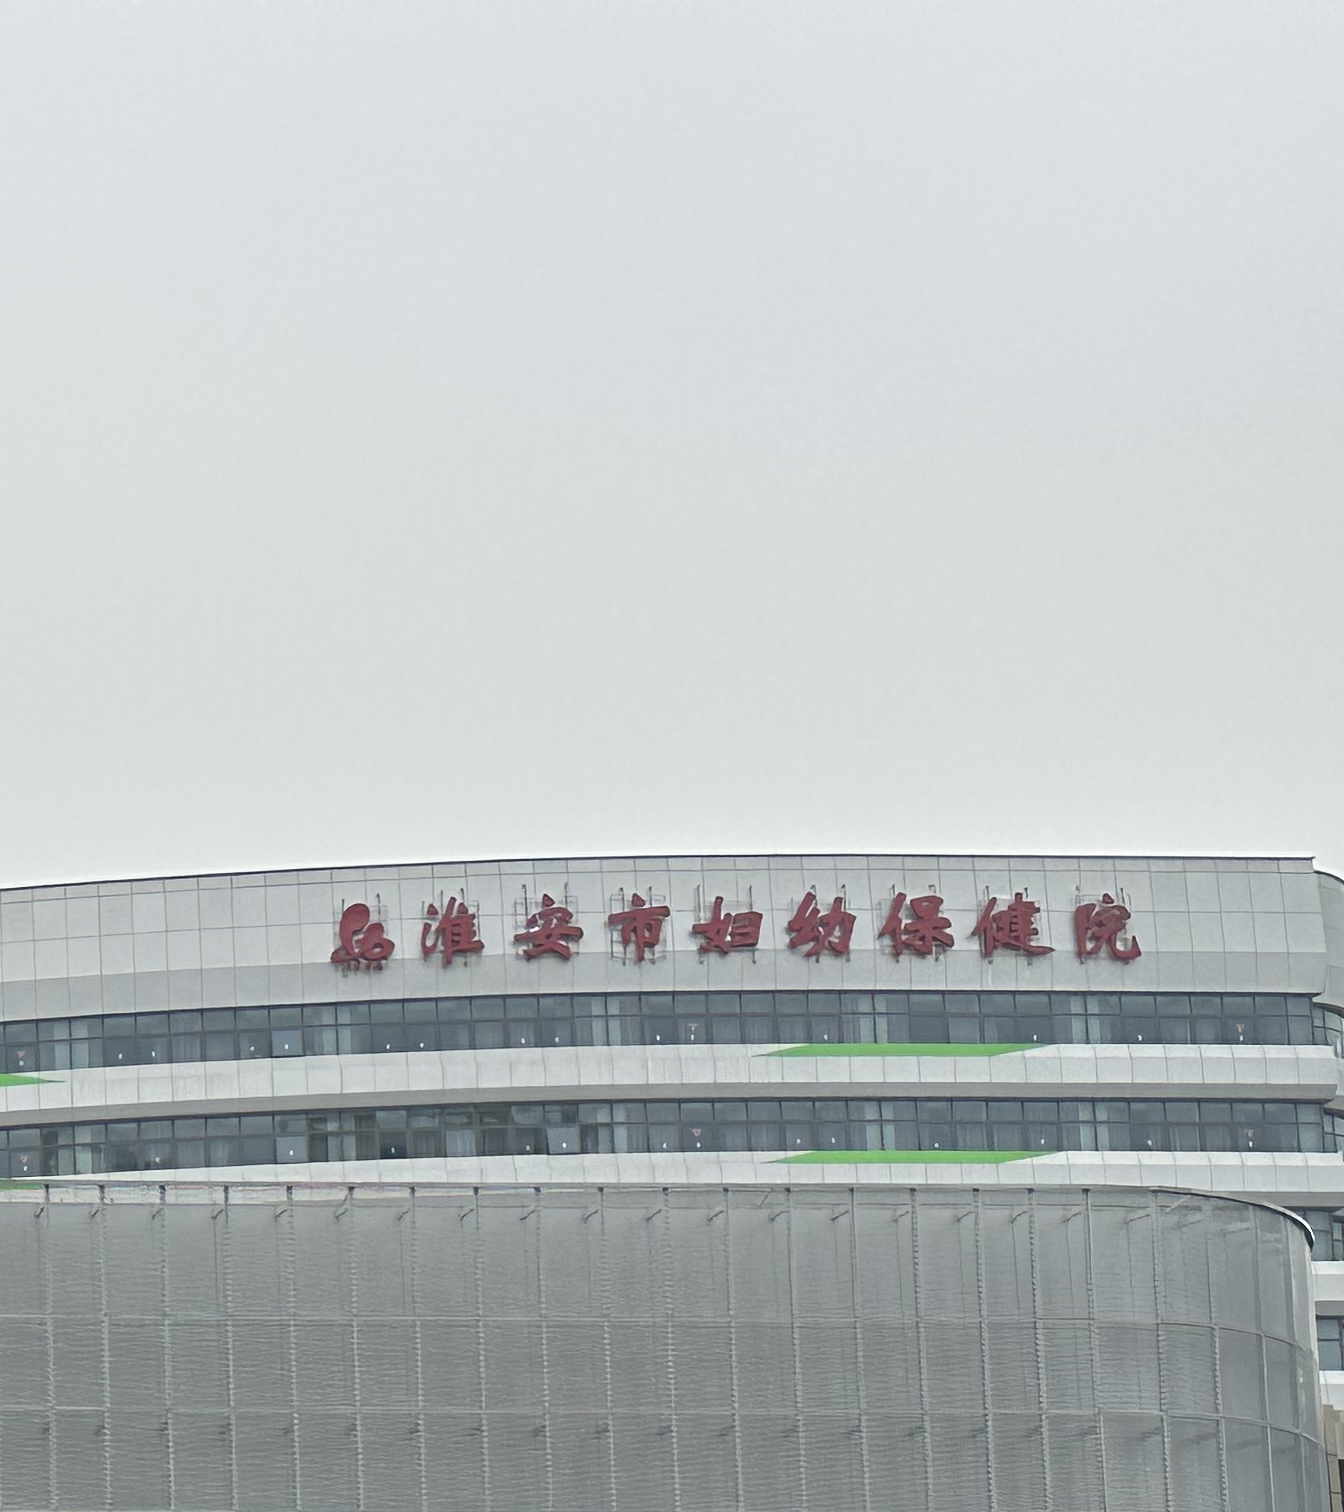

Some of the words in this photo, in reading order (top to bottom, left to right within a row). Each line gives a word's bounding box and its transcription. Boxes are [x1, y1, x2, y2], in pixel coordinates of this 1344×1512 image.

[421, 893, 1141, 964] 淮安市妇幼保健院
